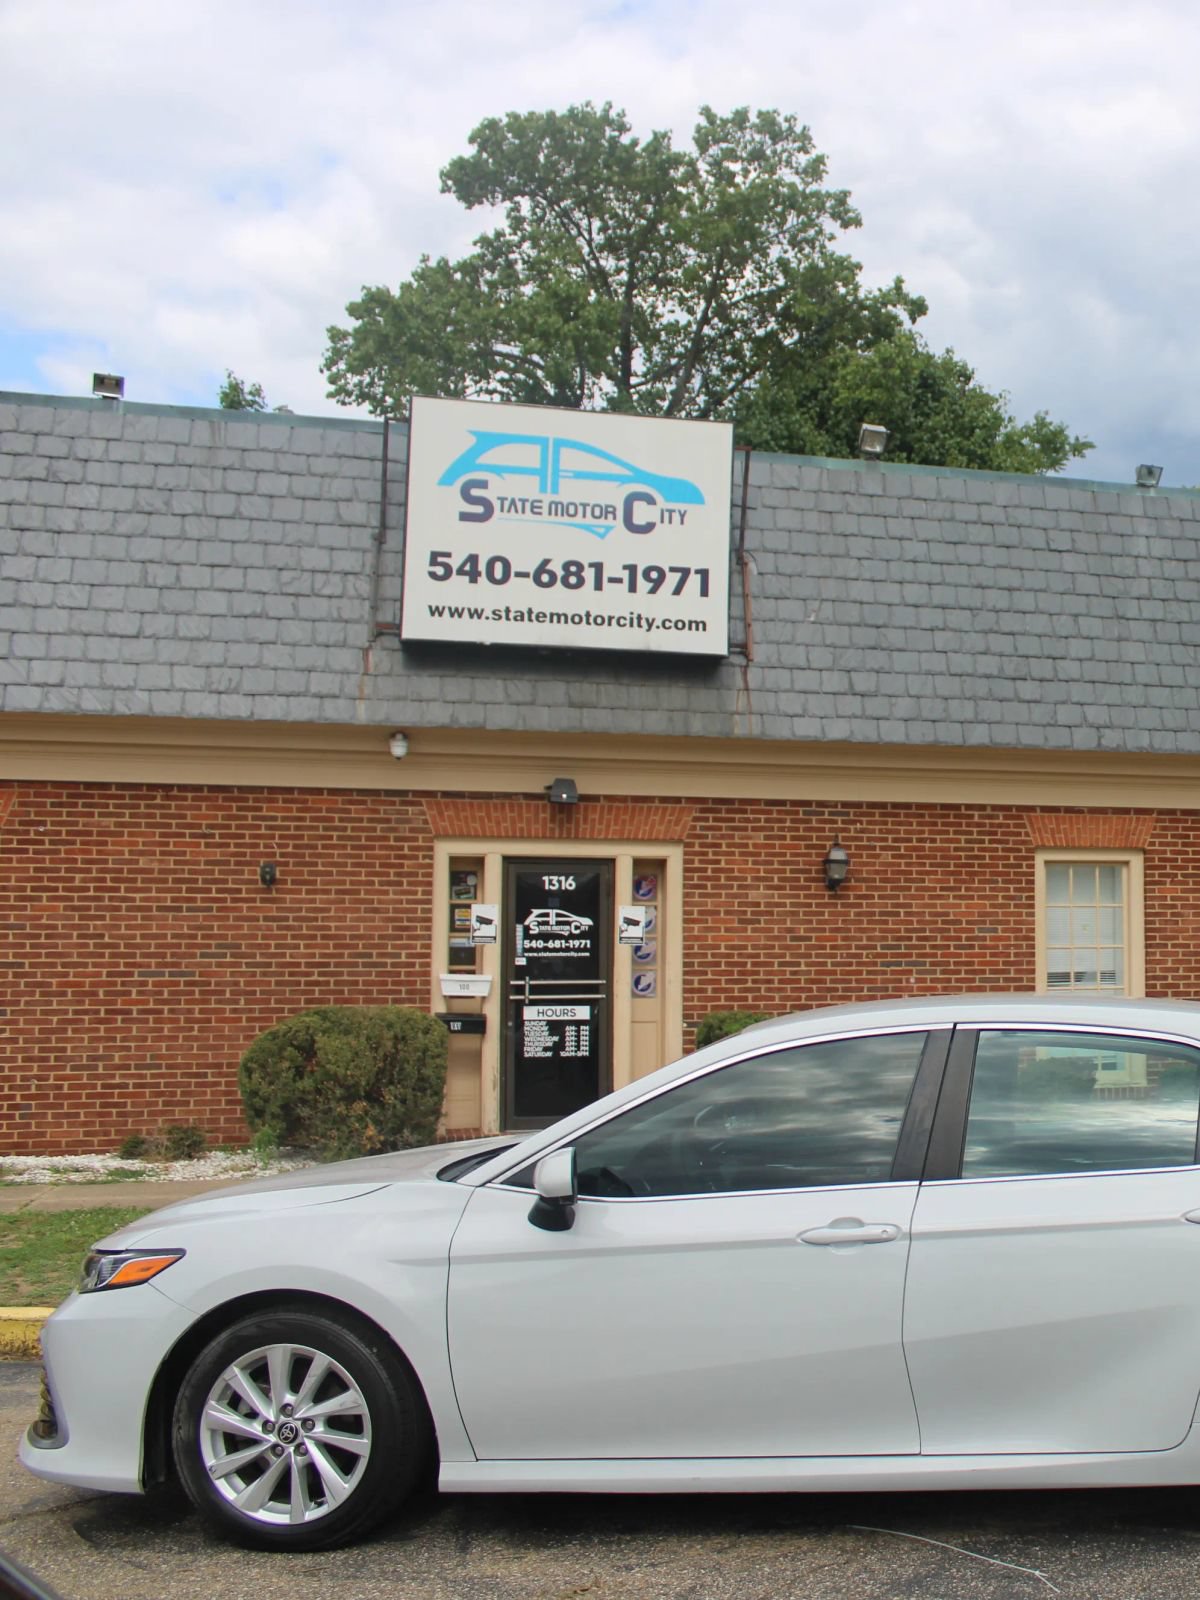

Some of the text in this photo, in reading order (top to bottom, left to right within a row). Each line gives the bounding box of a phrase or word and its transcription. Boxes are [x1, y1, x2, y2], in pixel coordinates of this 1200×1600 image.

[548, 500, 617, 521] MOTOR
[427, 550, 710, 598] 540-681-1971
[427, 604, 708, 632] www.statemotorcity.com
[542, 875, 576, 890] 1316
[523, 939, 591, 949] 540-681-1971
[537, 1008, 577, 1017] HOURS
